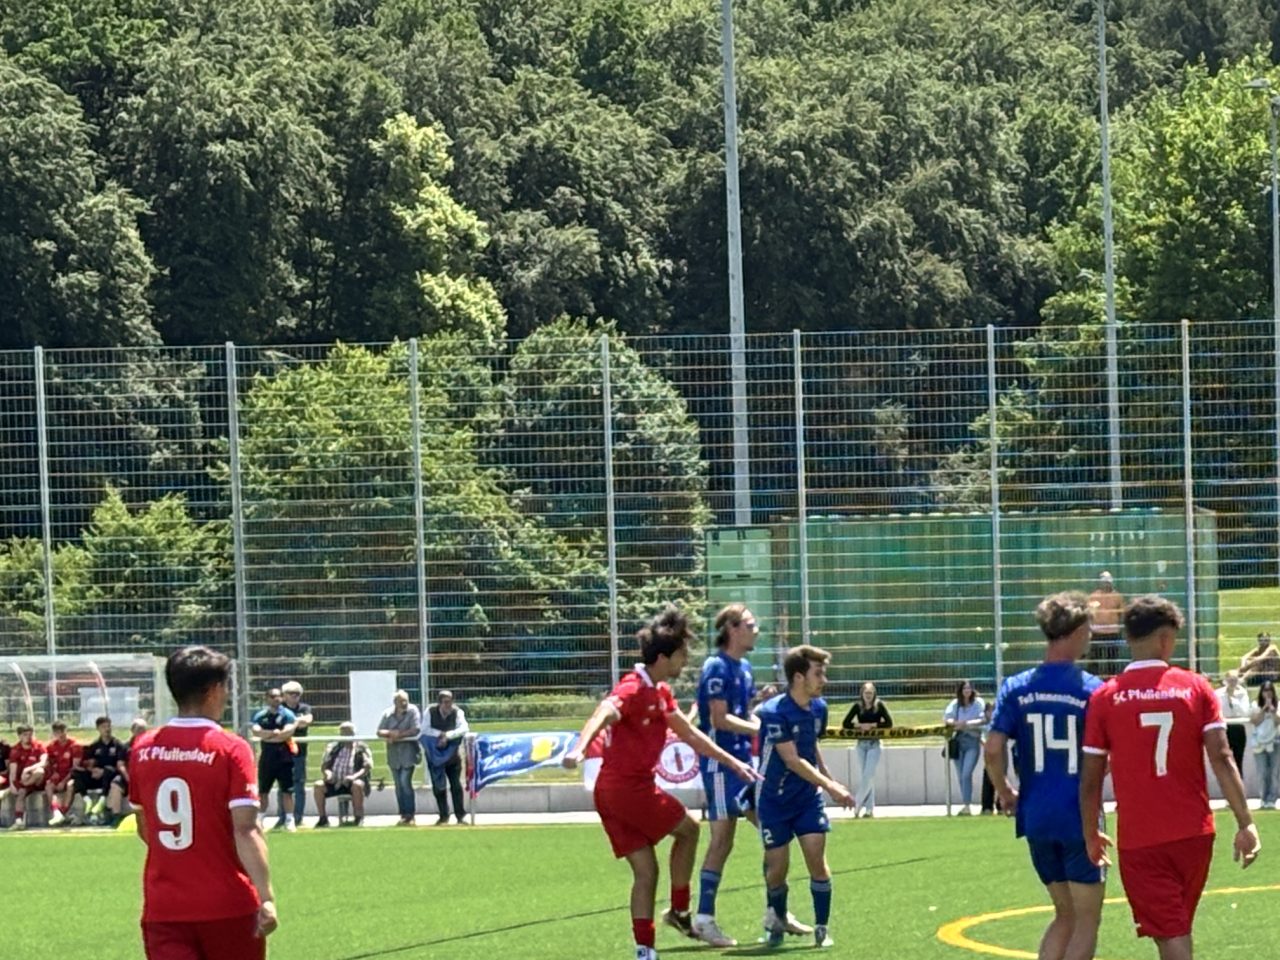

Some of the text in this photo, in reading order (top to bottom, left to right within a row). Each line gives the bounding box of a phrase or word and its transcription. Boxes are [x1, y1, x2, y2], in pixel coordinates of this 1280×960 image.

[1113, 687, 1192, 705] SC Pfullendorf
[138, 745, 216, 766] SC Pfullendorf
[1026, 712, 1078, 775] 14
[1139, 711, 1174, 777] 7
[156, 777, 193, 850] 9
